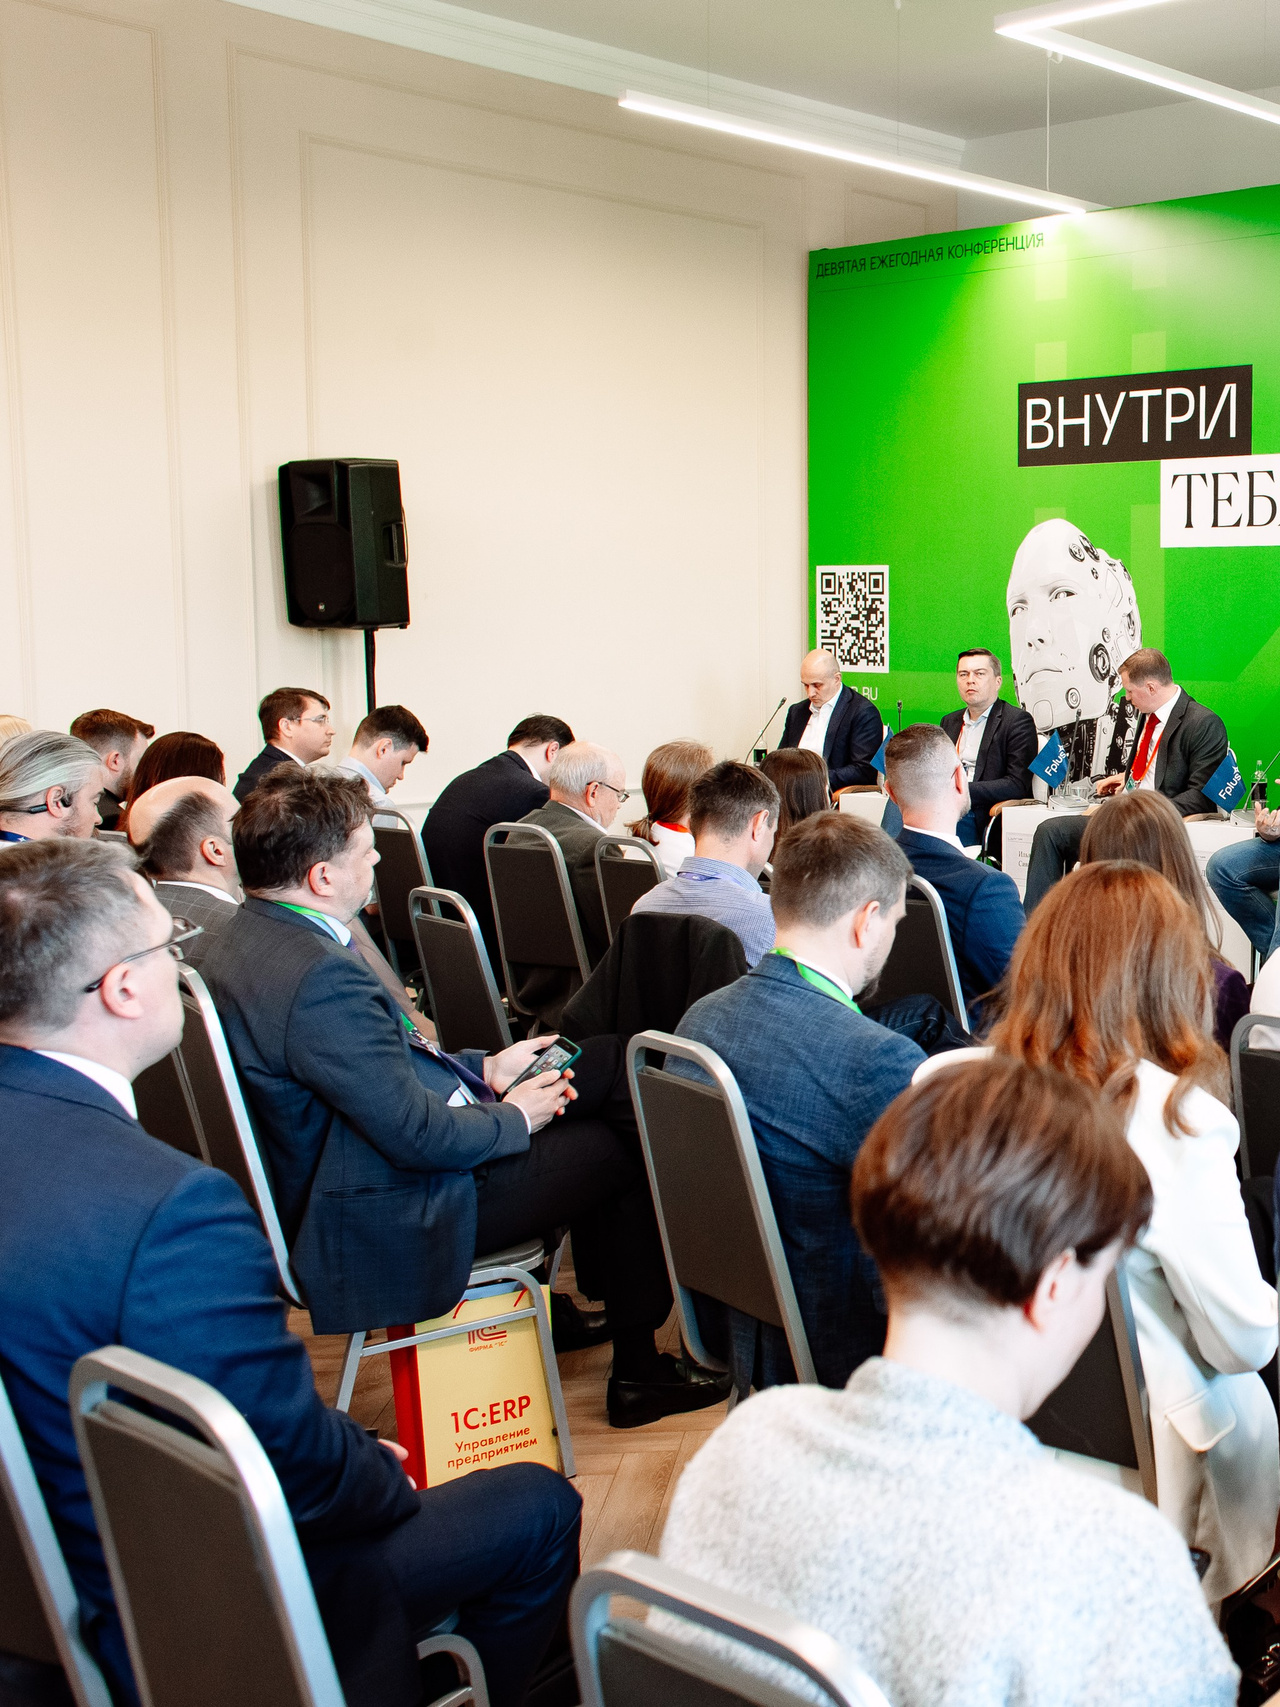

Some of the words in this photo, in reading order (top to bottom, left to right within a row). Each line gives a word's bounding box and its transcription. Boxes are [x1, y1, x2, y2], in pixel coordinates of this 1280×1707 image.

[816, 258, 866, 279] ДЕВЯТАЯ
[870, 247, 944, 271] ЕЖЕГОДНАЯ
[948, 233, 1044, 259] КОНФЕРЕНЦИЯ
[1025, 383, 1238, 450] ВНУТРИ
[1044, 751, 1066, 777] Fplus
[1218, 772, 1242, 800] Fplus
[469, 1344, 493, 1352] ФИРМА
[447, 1438, 538, 1470] предприятием
[455, 1427, 530, 1453] Управление
